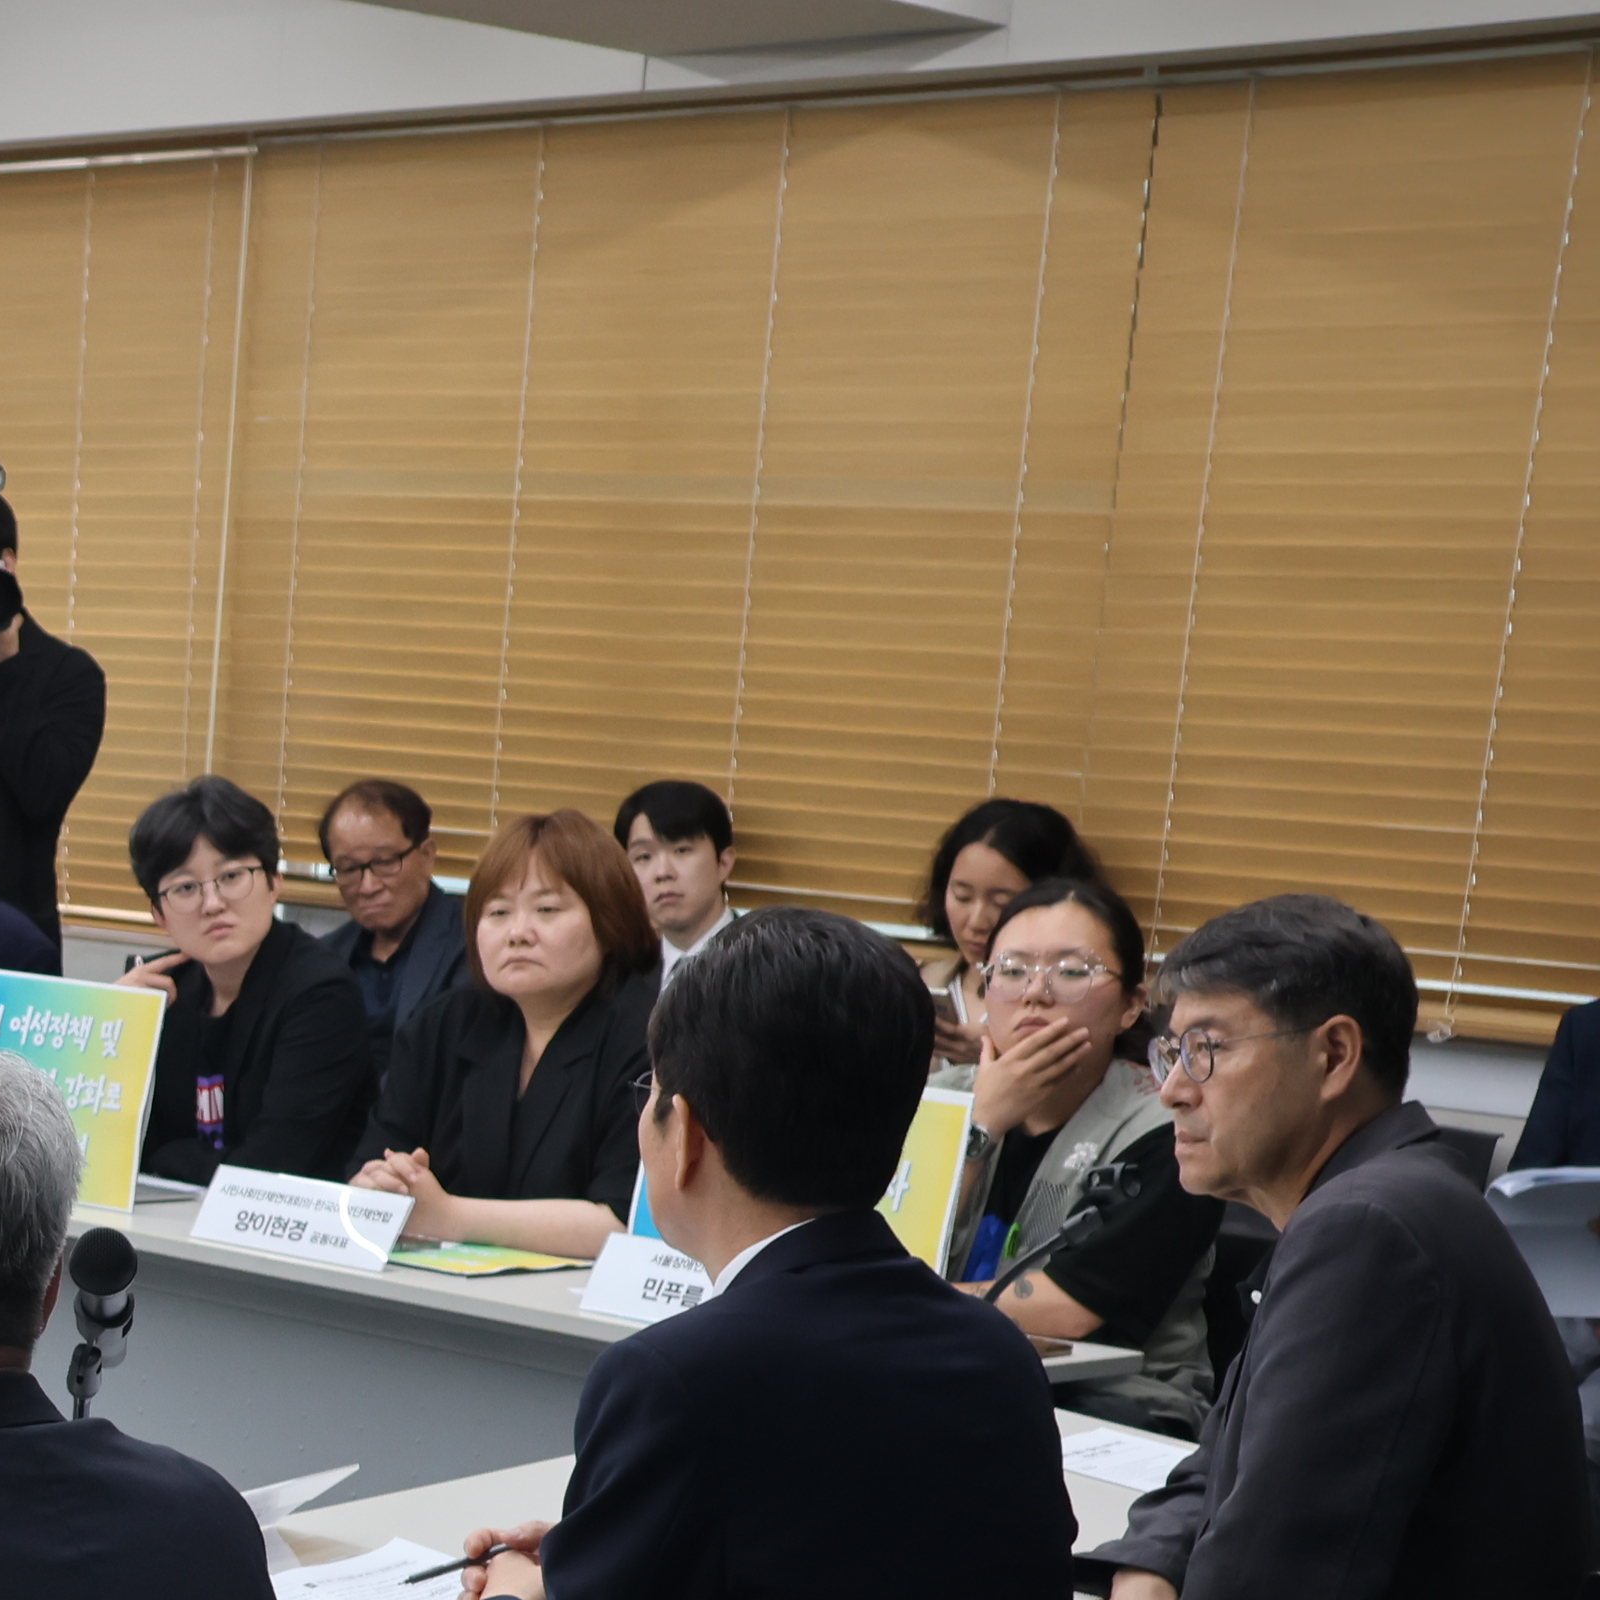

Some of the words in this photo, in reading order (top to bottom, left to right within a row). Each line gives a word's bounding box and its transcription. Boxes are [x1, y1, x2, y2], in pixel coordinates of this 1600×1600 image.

[9, 1006, 94, 1053] 여성정책
[100, 1018, 124, 1058] 및
[65, 1073, 122, 1116] 강화로
[235, 1210, 308, 1241] 양이현경
[310, 1231, 349, 1249] 공동대표
[642, 1277, 705, 1308] 민푸름
